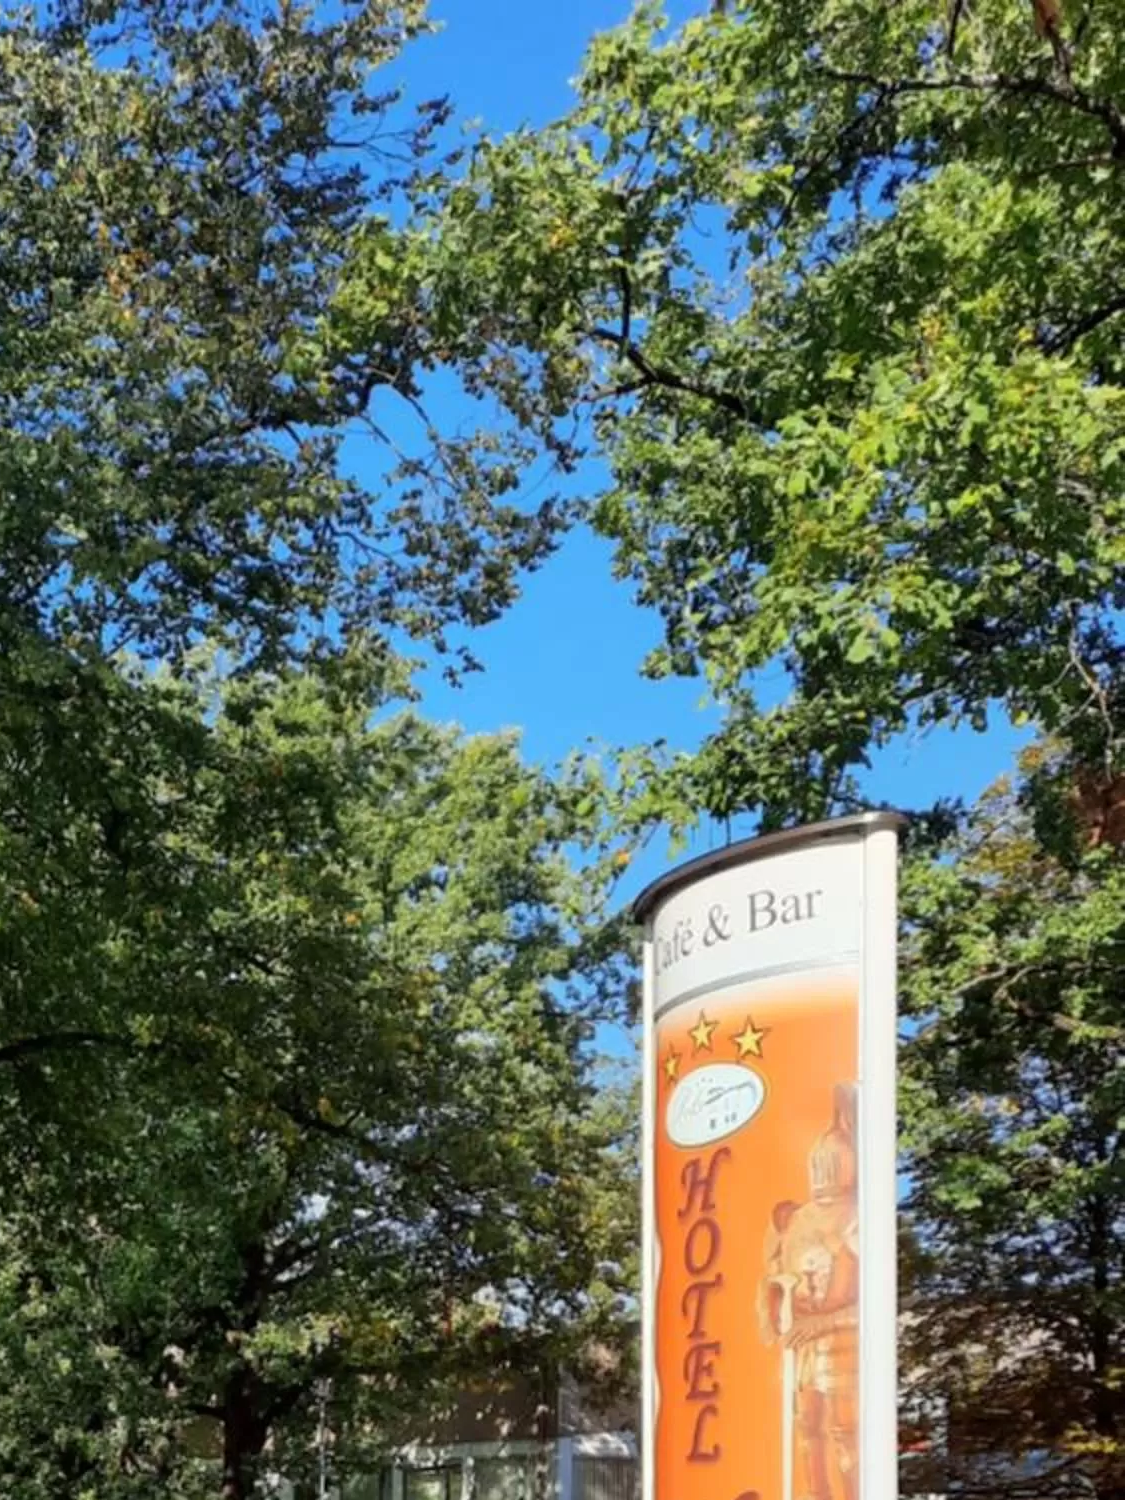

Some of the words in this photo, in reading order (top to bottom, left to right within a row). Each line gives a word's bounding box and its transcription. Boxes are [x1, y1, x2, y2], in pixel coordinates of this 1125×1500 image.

[702, 903, 731, 947] &
[747, 888, 823, 932] Bar
[677, 1147, 731, 1463] HOTEL
